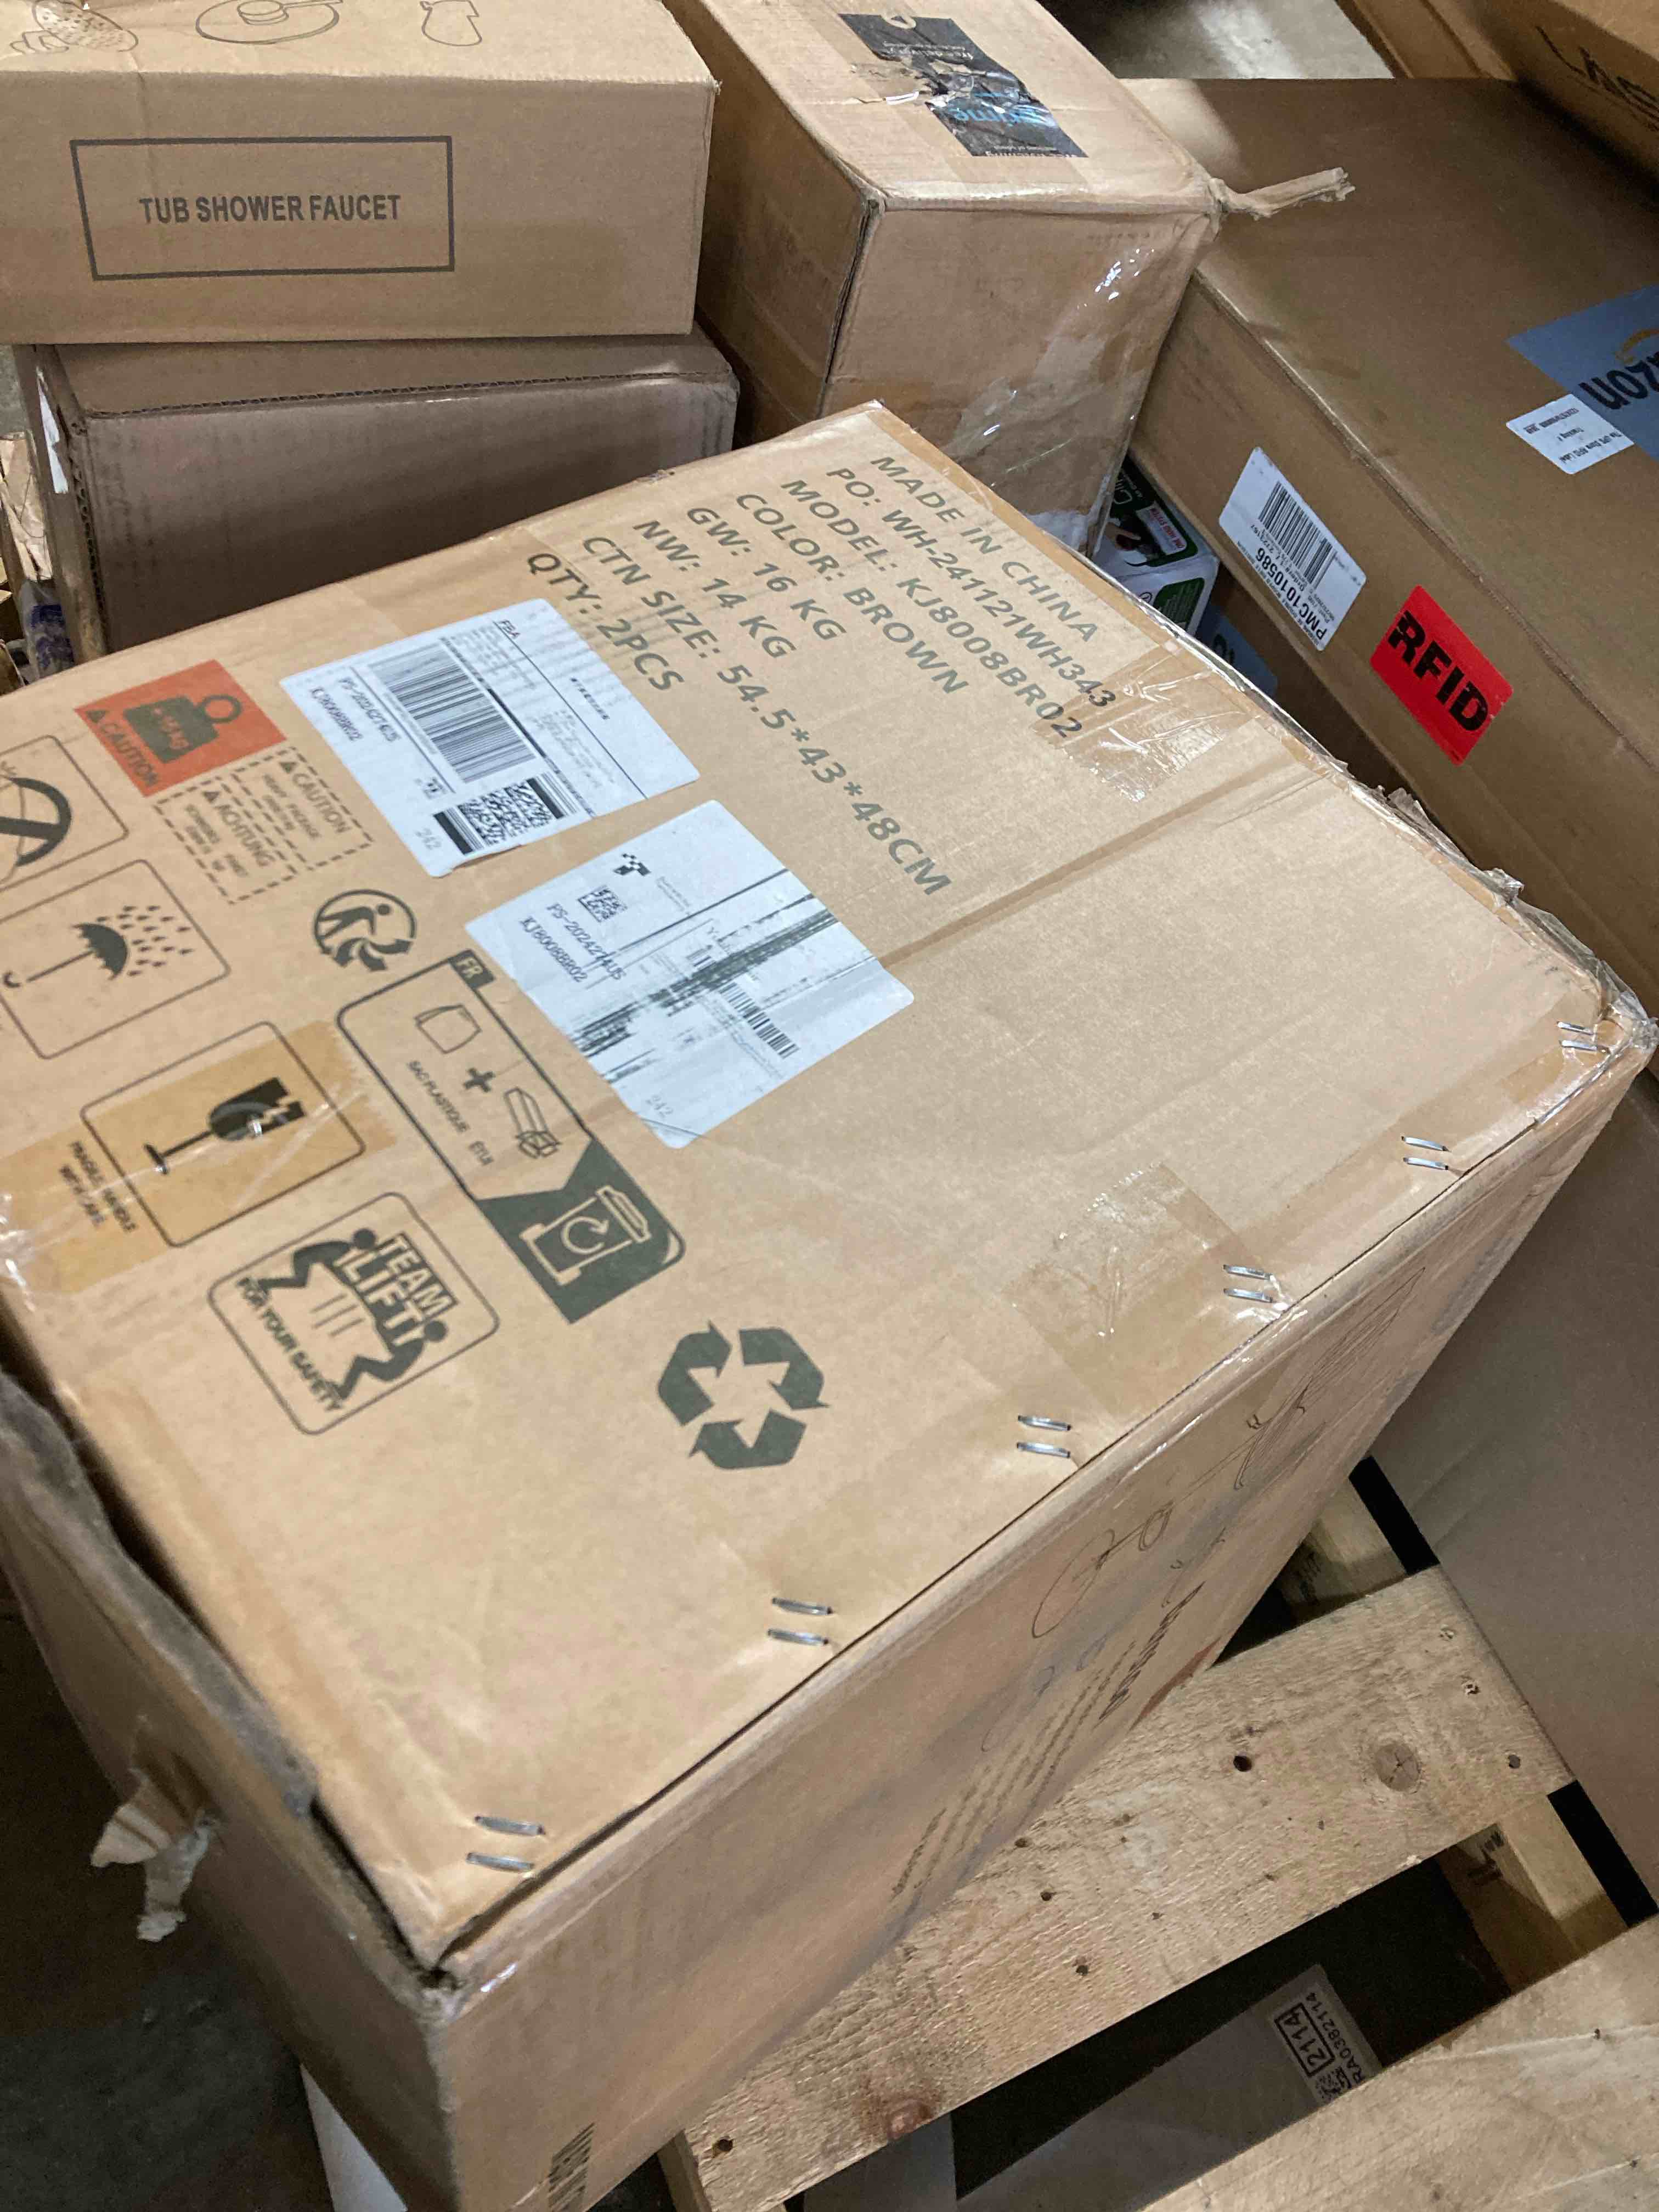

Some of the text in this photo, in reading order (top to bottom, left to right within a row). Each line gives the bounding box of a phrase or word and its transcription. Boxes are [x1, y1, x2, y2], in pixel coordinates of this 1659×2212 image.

[139, 194, 401, 224] TUB SHOWER FAUCET
[583, 536, 652, 585] CTN
[641, 590, 721, 659] SIZE:
[633, 520, 797, 658] NW: 14 KG
[687, 507, 848, 641] GW: 16 KG
[736, 494, 969, 695] COLOR: BROWN
[781, 479, 1082, 738] MODEL: KJ8008BR02
[826, 467, 882, 507] PO:
[882, 509, 1116, 708] WH-241121WH343
[870, 456, 964, 523] MADE
[960, 526, 1003, 555] IN
[1002, 561, 1098, 642] CHINA
[1255, 547, 1328, 641] PMC1010586
[527, 552, 602, 614] QTY:
[596, 618, 685, 691] 2PCS
[1387, 609, 1489, 731] RFID
[291, 772, 352, 834] CAUTION
[456, 958, 483, 979] FR
[519, 916, 588, 983] KJ8008BR02
[342, 1251, 425, 1330] LIFT
[379, 1237, 454, 1317] TEAM
[1284, 2011, 1326, 2067] 2114
